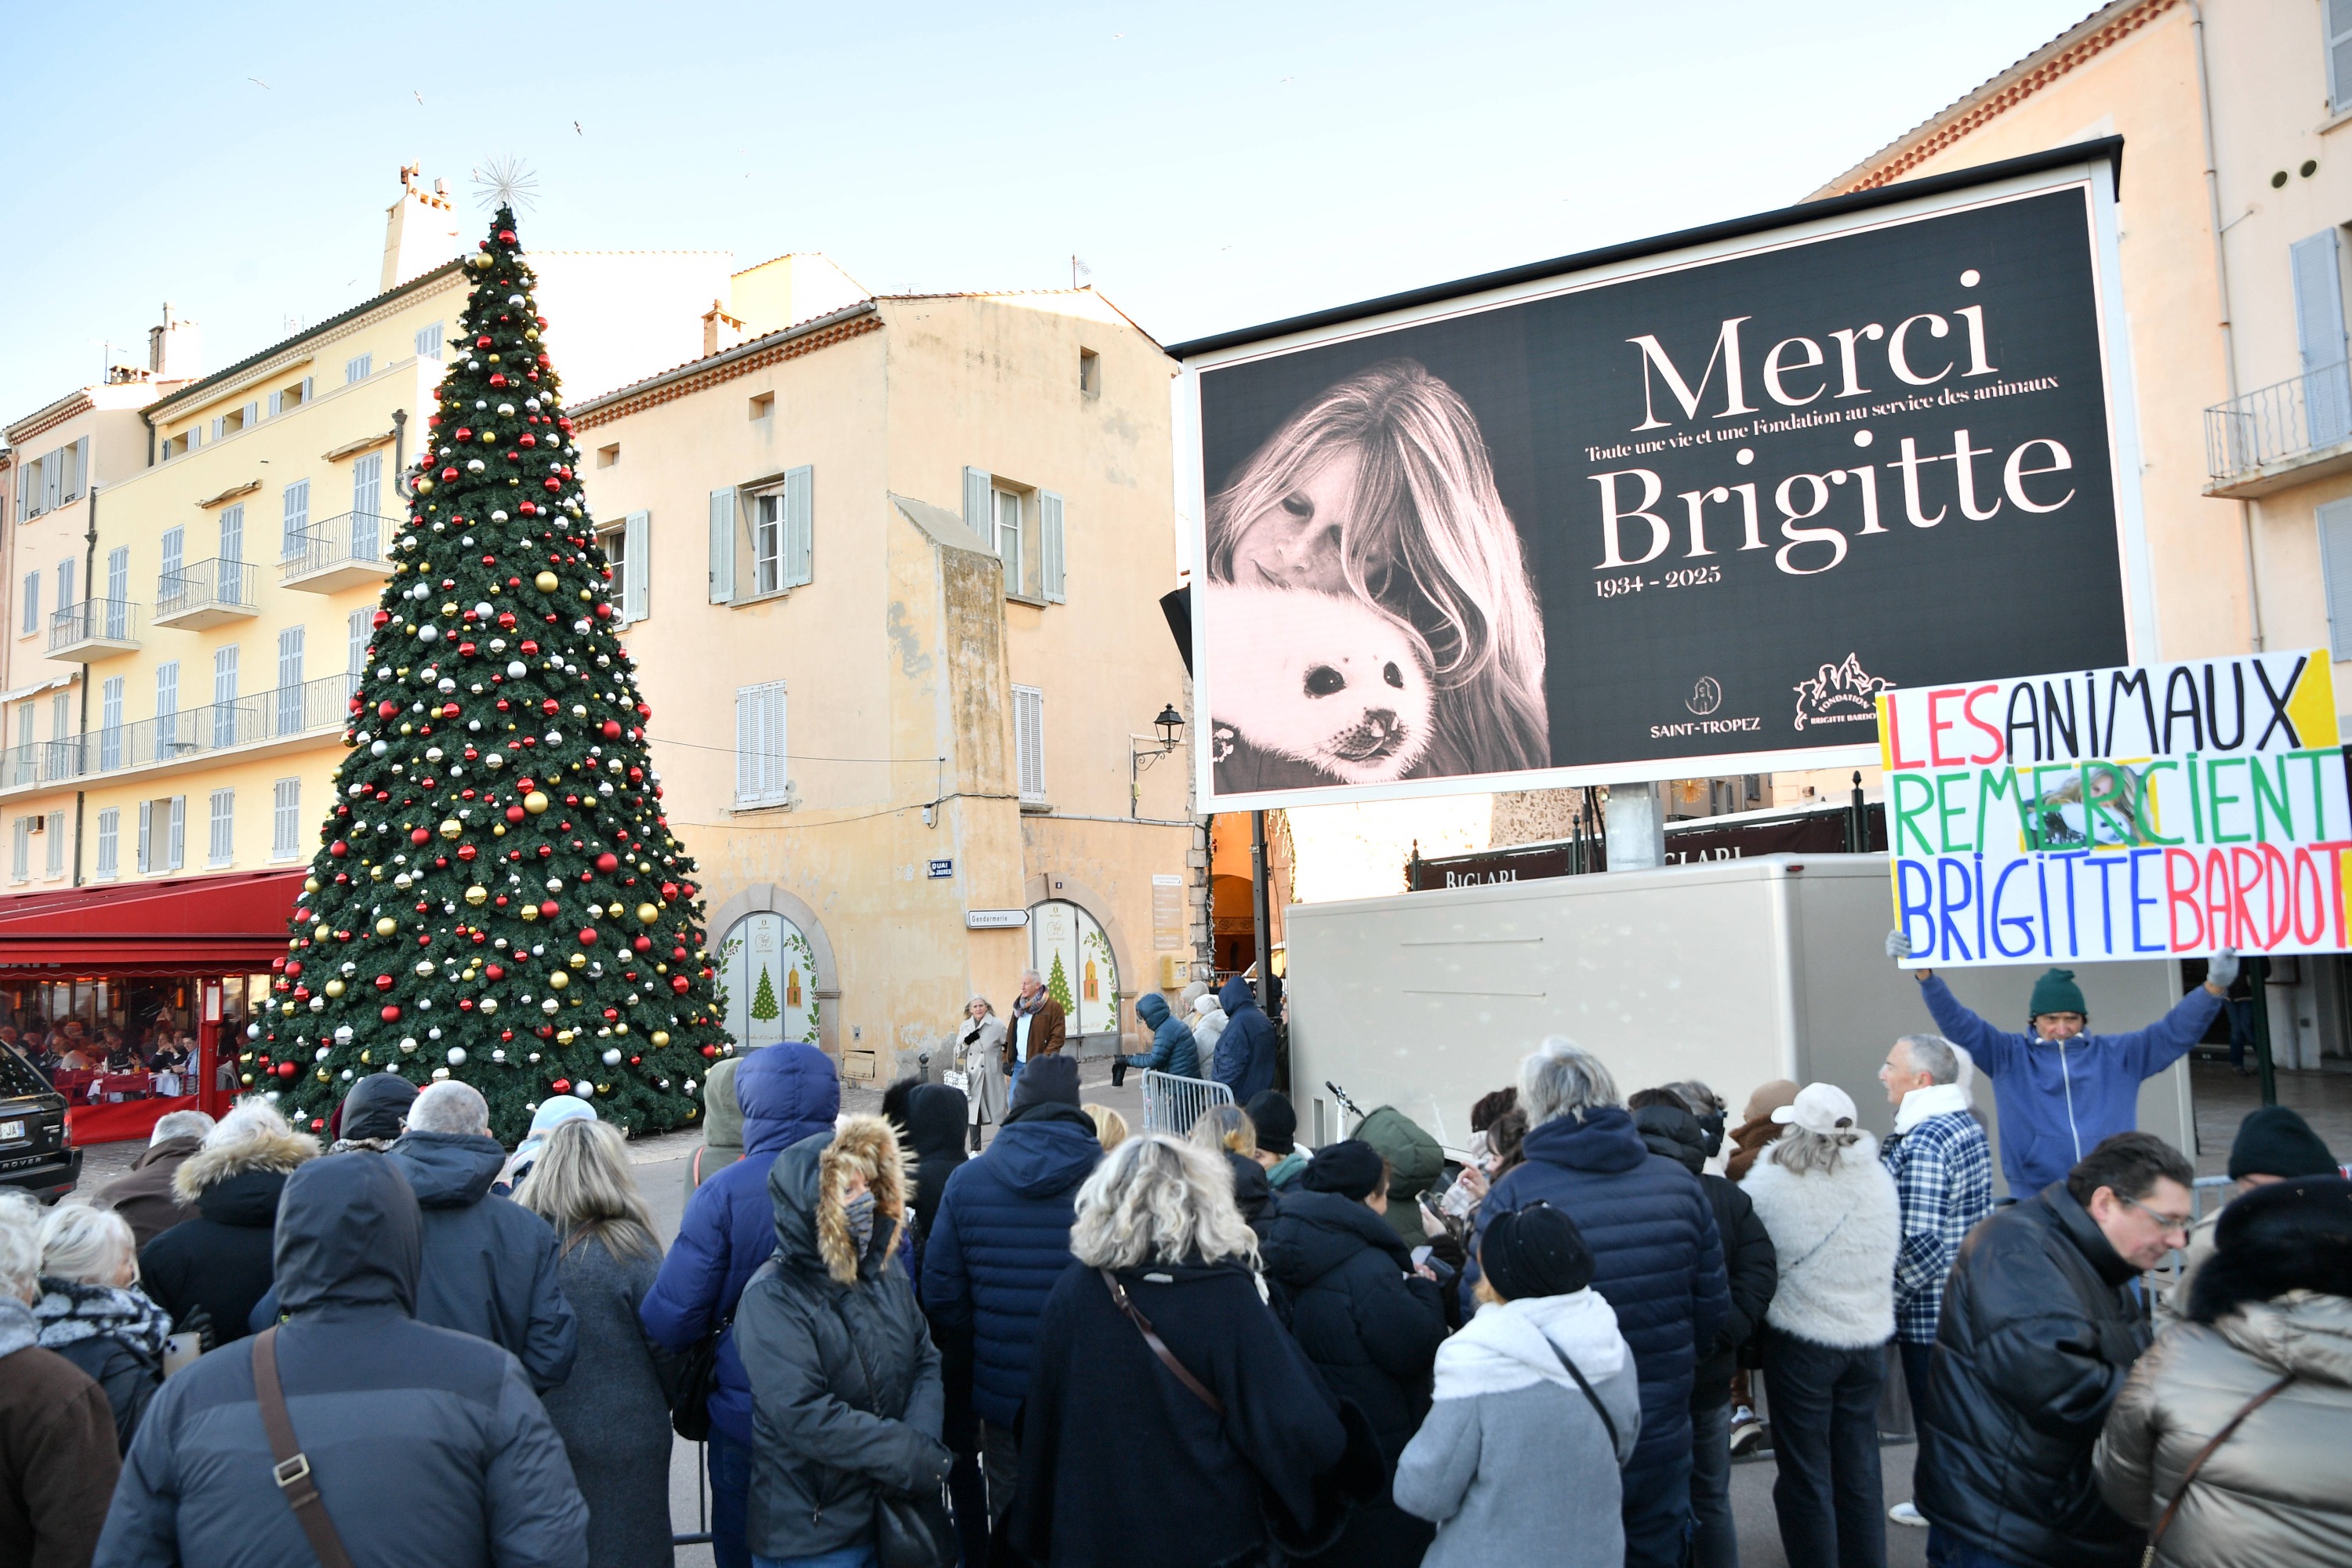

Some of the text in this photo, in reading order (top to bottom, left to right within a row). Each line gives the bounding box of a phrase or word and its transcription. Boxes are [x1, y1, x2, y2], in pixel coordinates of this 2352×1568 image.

[1625, 270, 1999, 432] Merci
[1584, 376, 2060, 462] Toute une vie et une Fondation au service des animaux
[1587, 429, 2077, 575] Brigitte
[1595, 575, 1643, 598] 1934
[1664, 565, 1721, 588] 2025
[1650, 717, 1761, 739] SAINT-TROPEZ
[1818, 694, 1871, 713] FONDATION
[1846, 712, 1877, 722] BARDO
[1888, 656, 2308, 770] LES ANIMAUX
[1892, 749, 2343, 856] REMERCIENT
[1897, 840, 2352, 961] BRIGITTE BARDOT
[2, 1157, 42, 1169] ROVER
